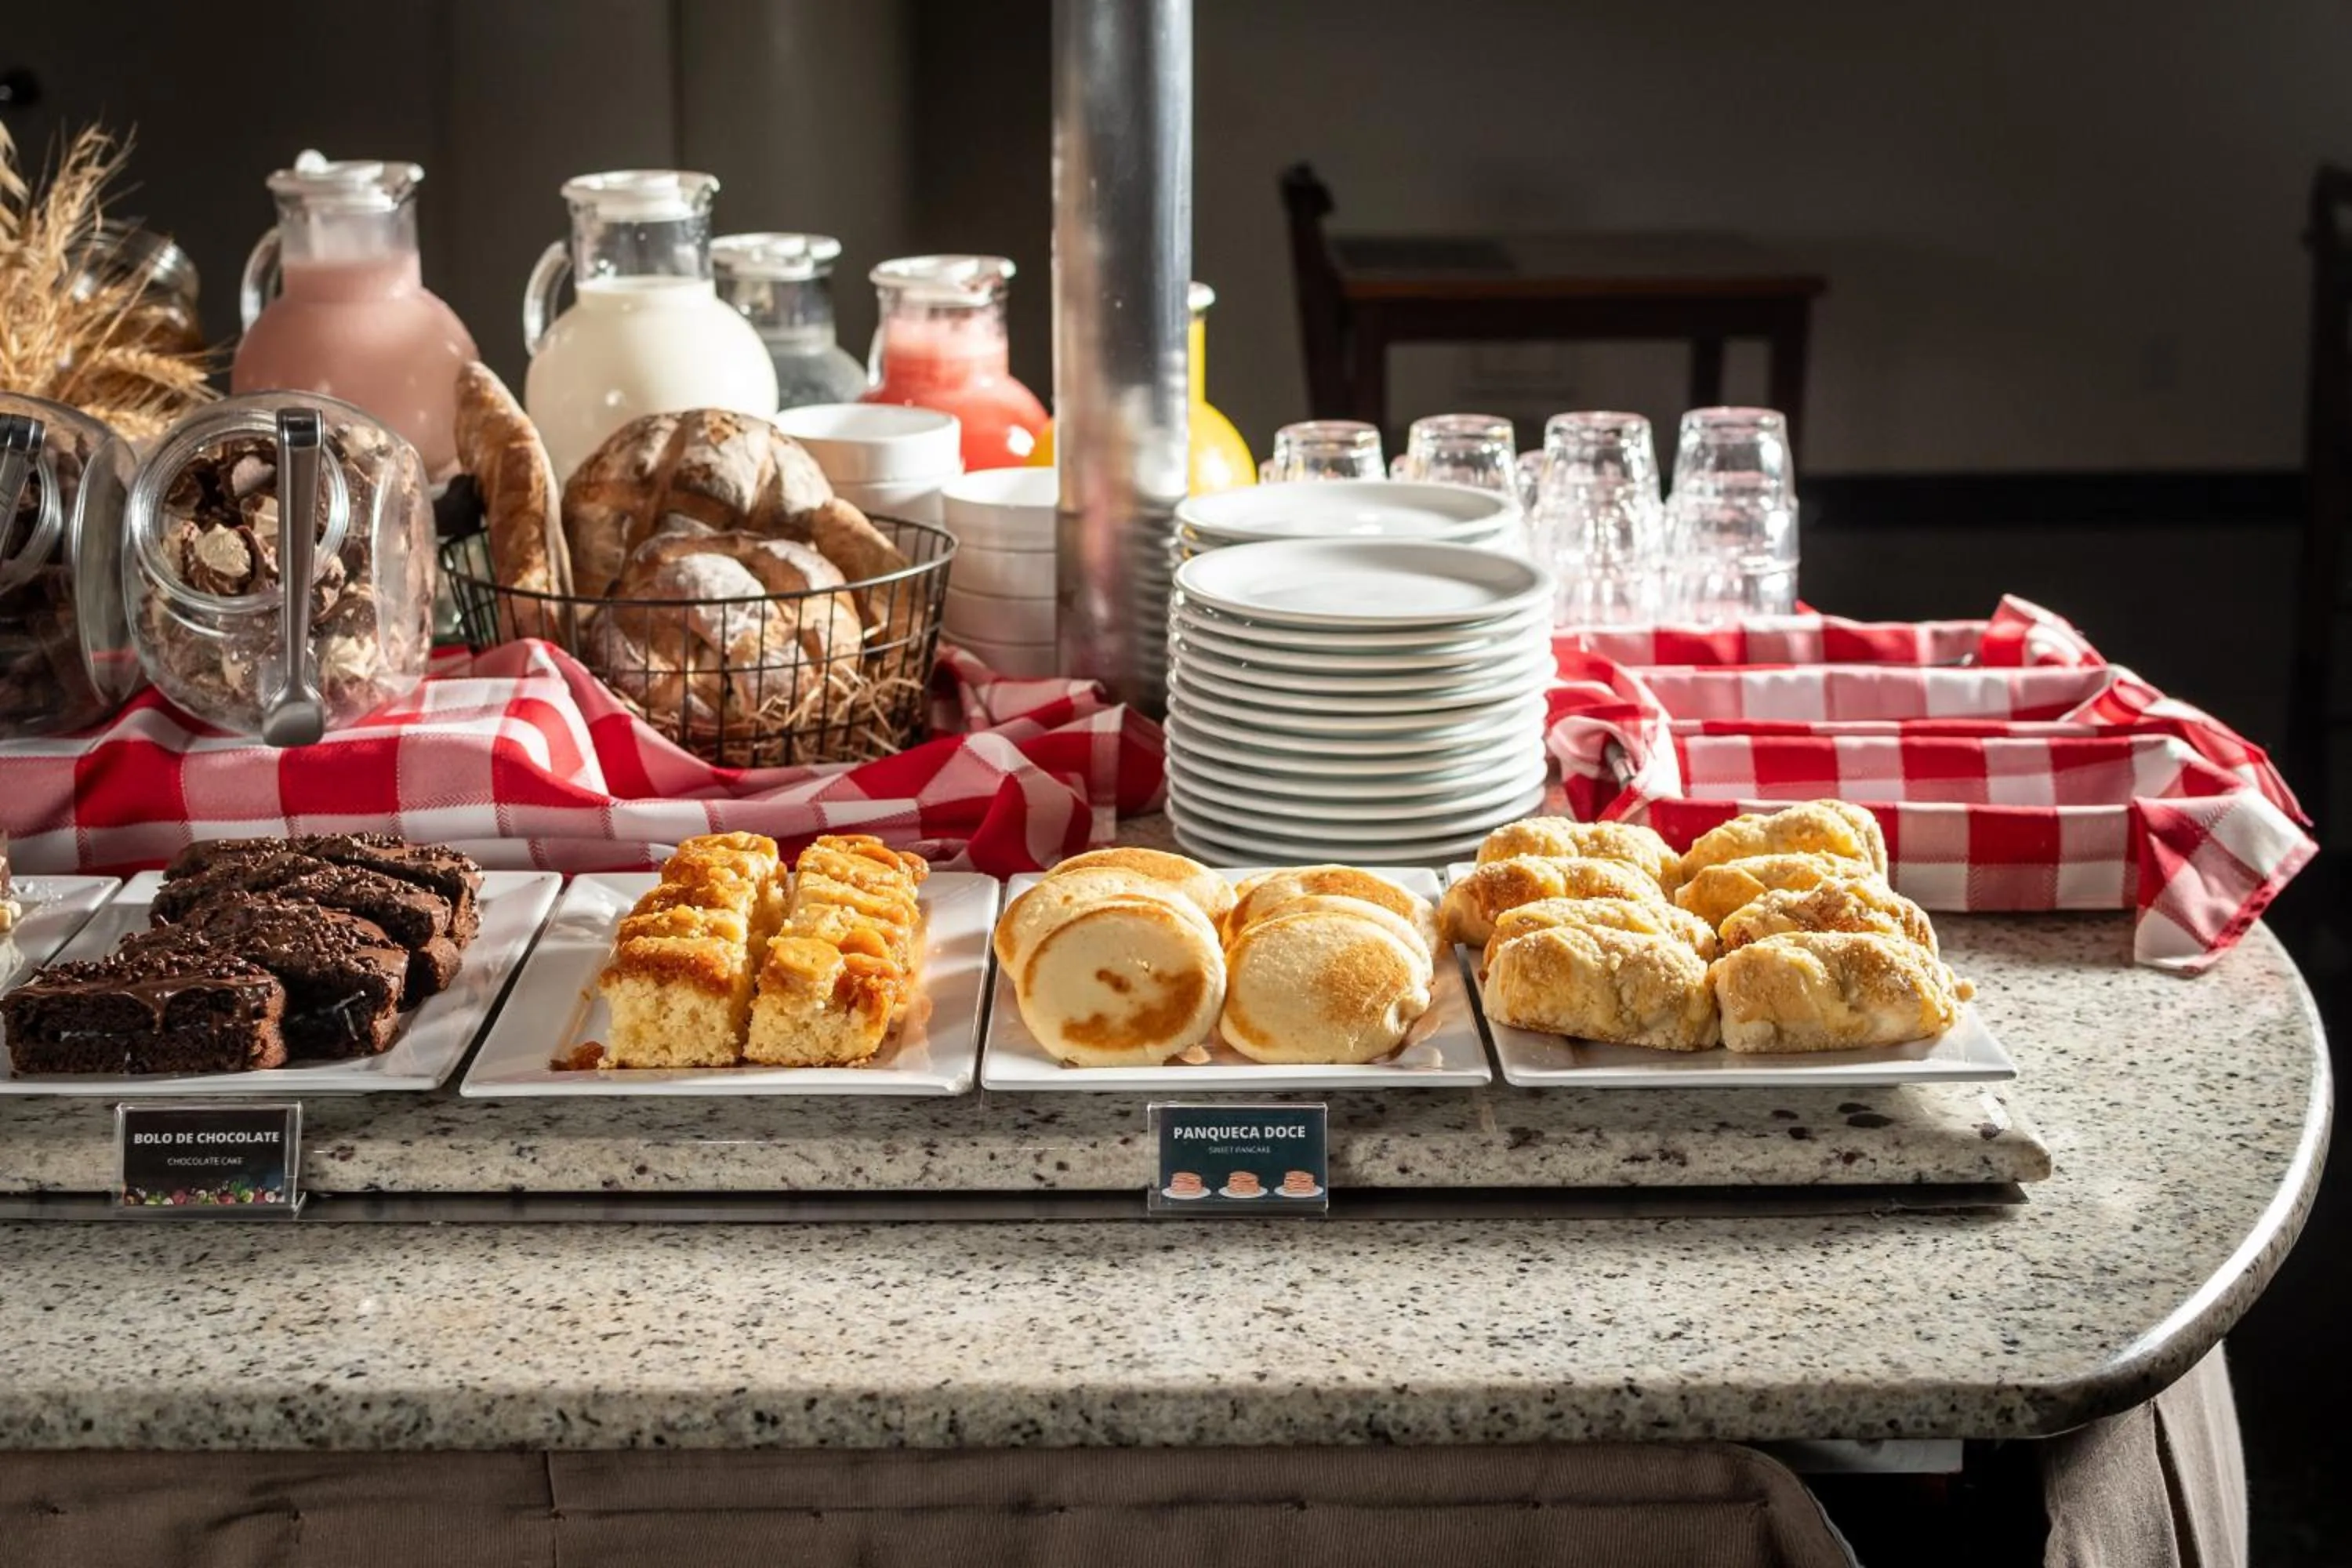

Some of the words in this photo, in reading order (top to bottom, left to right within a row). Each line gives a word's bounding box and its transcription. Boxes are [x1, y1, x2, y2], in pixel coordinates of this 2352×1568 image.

[134, 1133, 173, 1144] BOLO
[176, 1132, 194, 1144] DE
[197, 1131, 279, 1143] CHOCOLATE
[1174, 1127, 1260, 1142] PANQUECA
[1264, 1126, 1305, 1138] DOCE
[167, 1157, 220, 1166] CHOCOLATE
